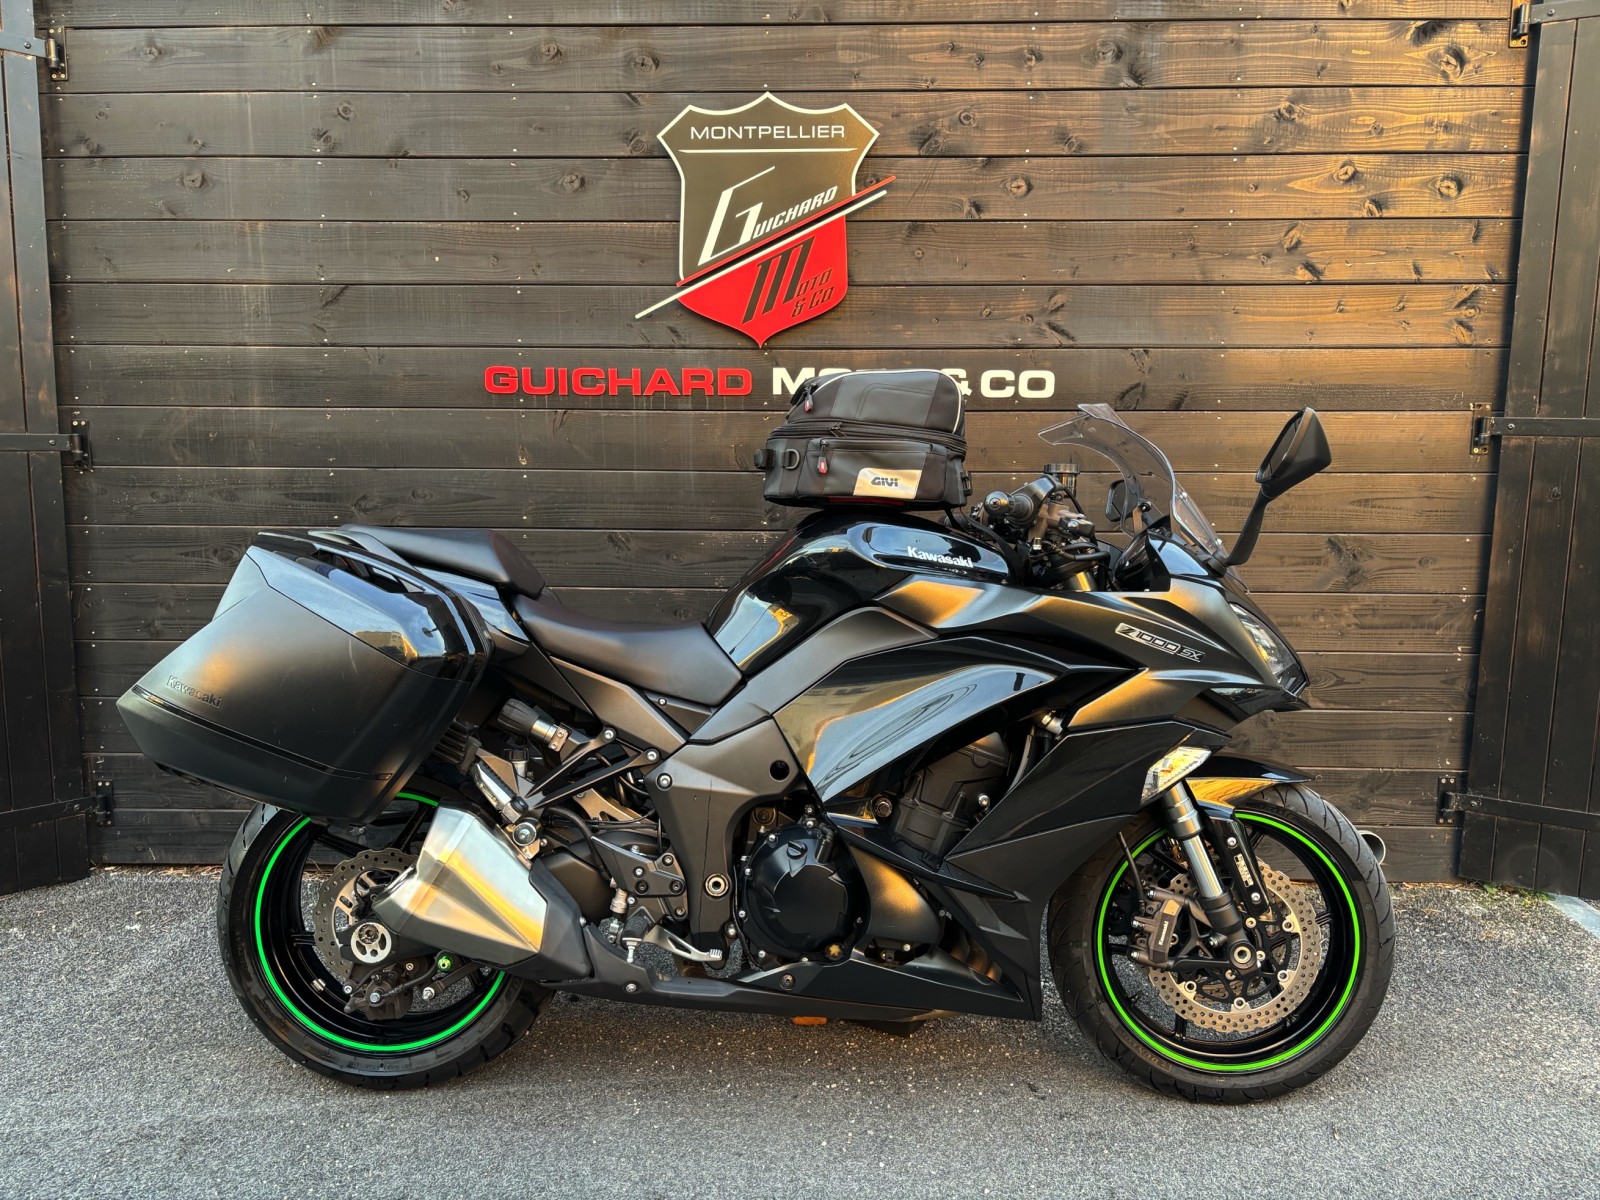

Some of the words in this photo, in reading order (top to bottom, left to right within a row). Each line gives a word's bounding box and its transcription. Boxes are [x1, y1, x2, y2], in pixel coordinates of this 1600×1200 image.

[690, 125, 846, 140] MONTPELLIER
[697, 165, 838, 267] GUICHARD
[791, 297, 806, 318] &
[808, 286, 834, 309] CO
[484, 366, 752, 396] GUICHARD
[980, 369, 1056, 398] CO
[870, 476, 899, 488] GIVI
[906, 545, 974, 569] Kawasaki
[166, 674, 223, 709] Kawasaki
